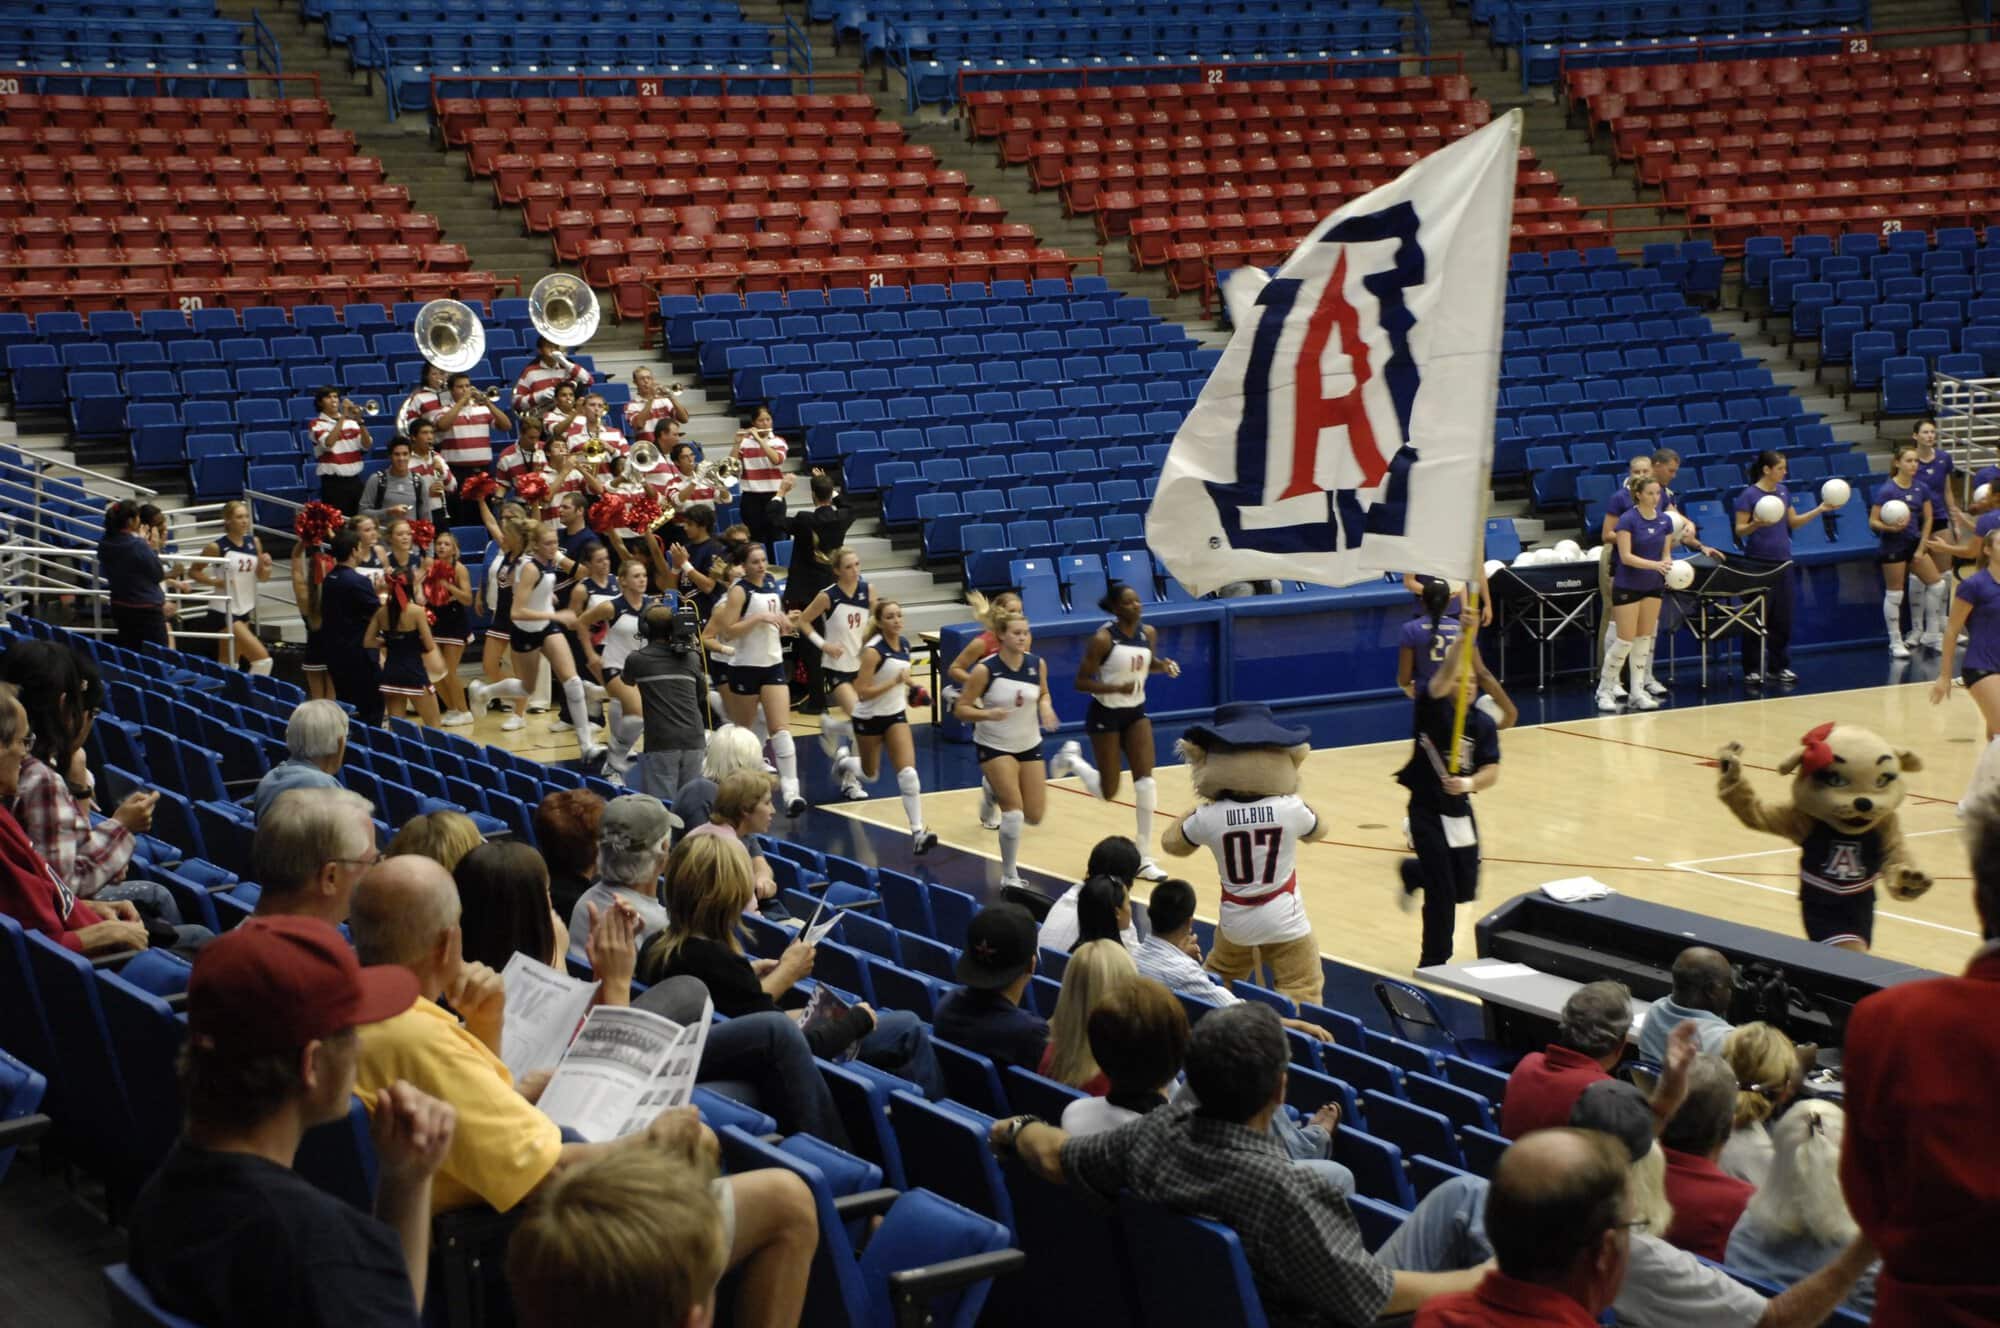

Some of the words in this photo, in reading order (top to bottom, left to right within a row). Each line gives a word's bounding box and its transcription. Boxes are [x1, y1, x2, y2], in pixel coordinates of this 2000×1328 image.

[1849, 40, 1868, 53] 23
[1208, 69, 1223, 84] 22
[0, 79, 19, 95] 20
[642, 82, 657, 97] 21
[870, 272, 884, 288] 21
[179, 296, 203, 314] 20
[847, 612, 861, 629] 99
[1226, 806, 1274, 826] WILBUR
[1222, 826, 1283, 885] 07
